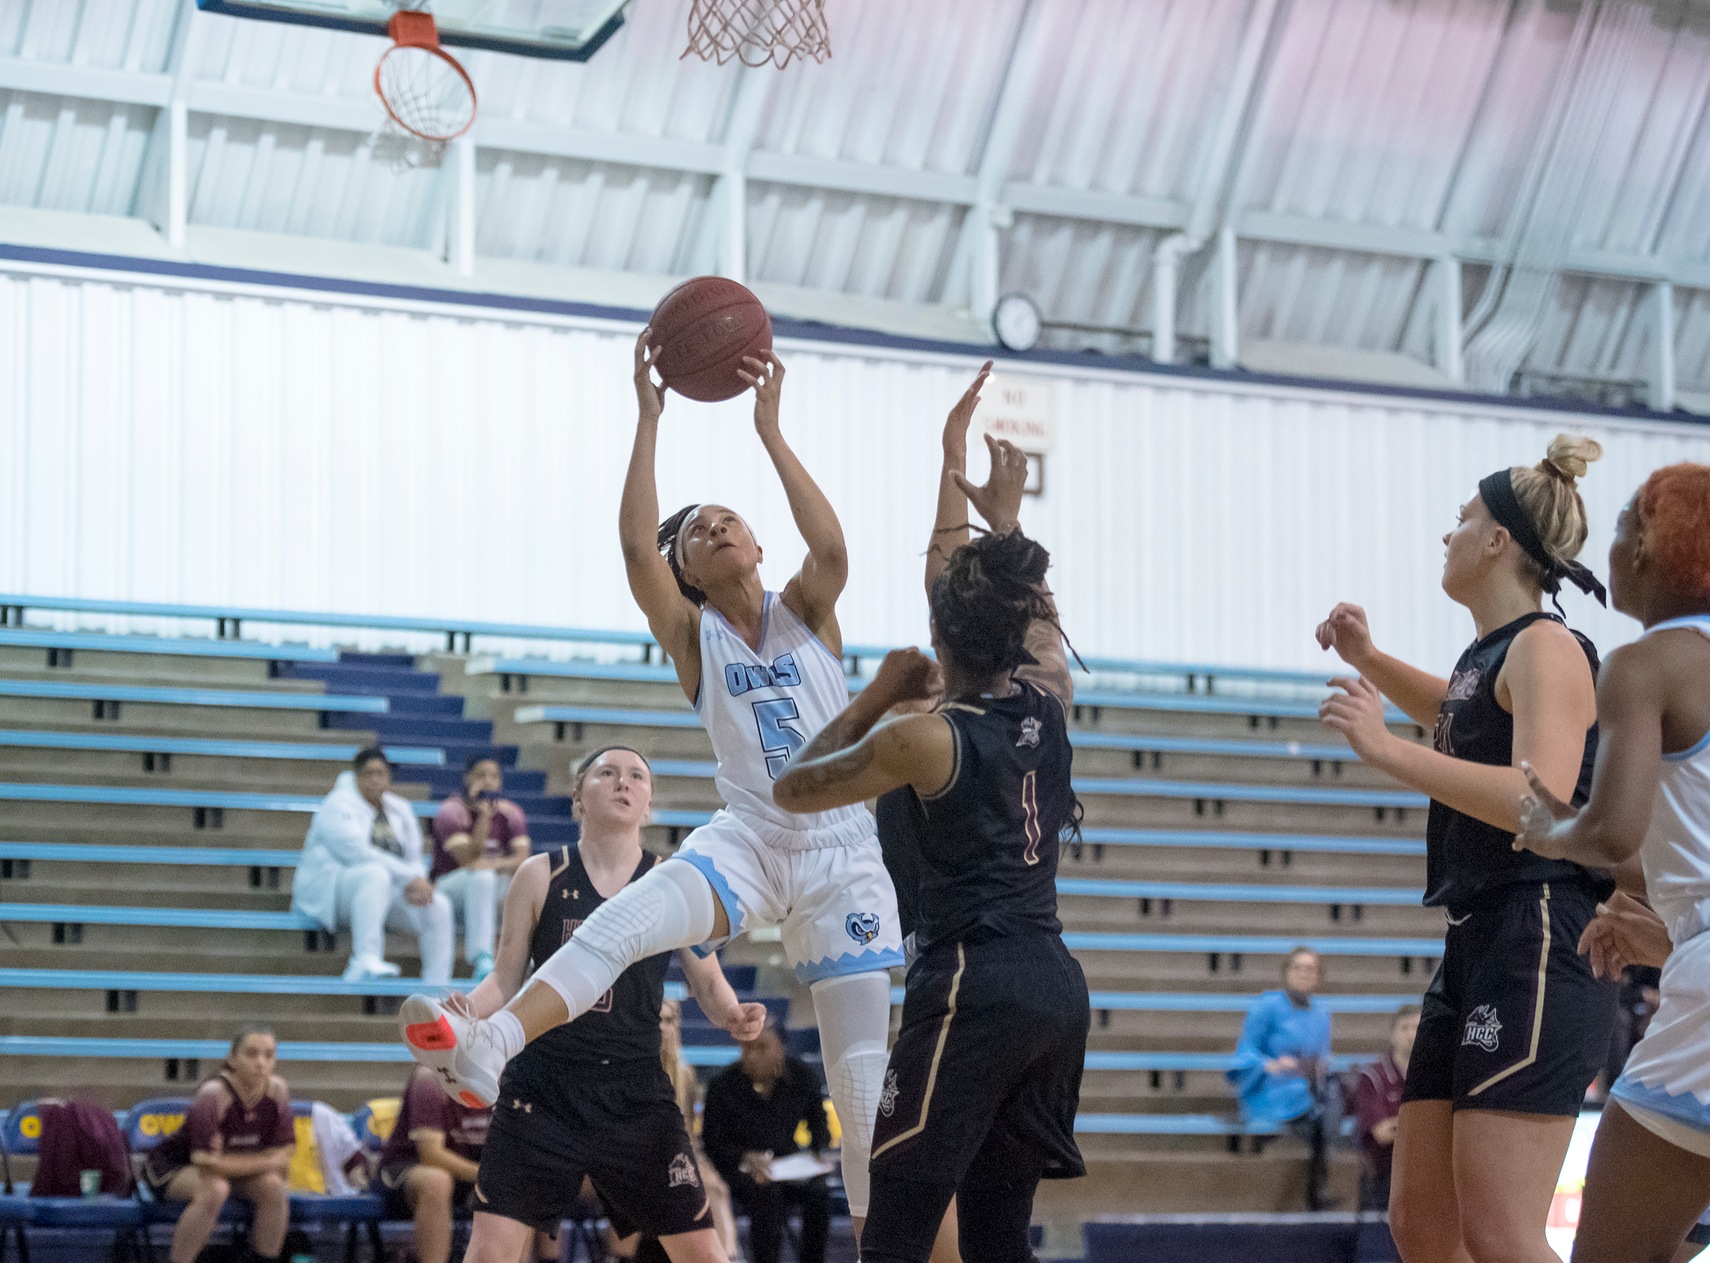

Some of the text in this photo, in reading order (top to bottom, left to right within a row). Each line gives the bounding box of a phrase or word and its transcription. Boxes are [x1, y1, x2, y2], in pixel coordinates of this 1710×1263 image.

[725, 652, 801, 697] OWLS
[752, 697, 807, 781] 5
[1022, 769, 1041, 866] 1
[1466, 1027, 1494, 1040] HCC
